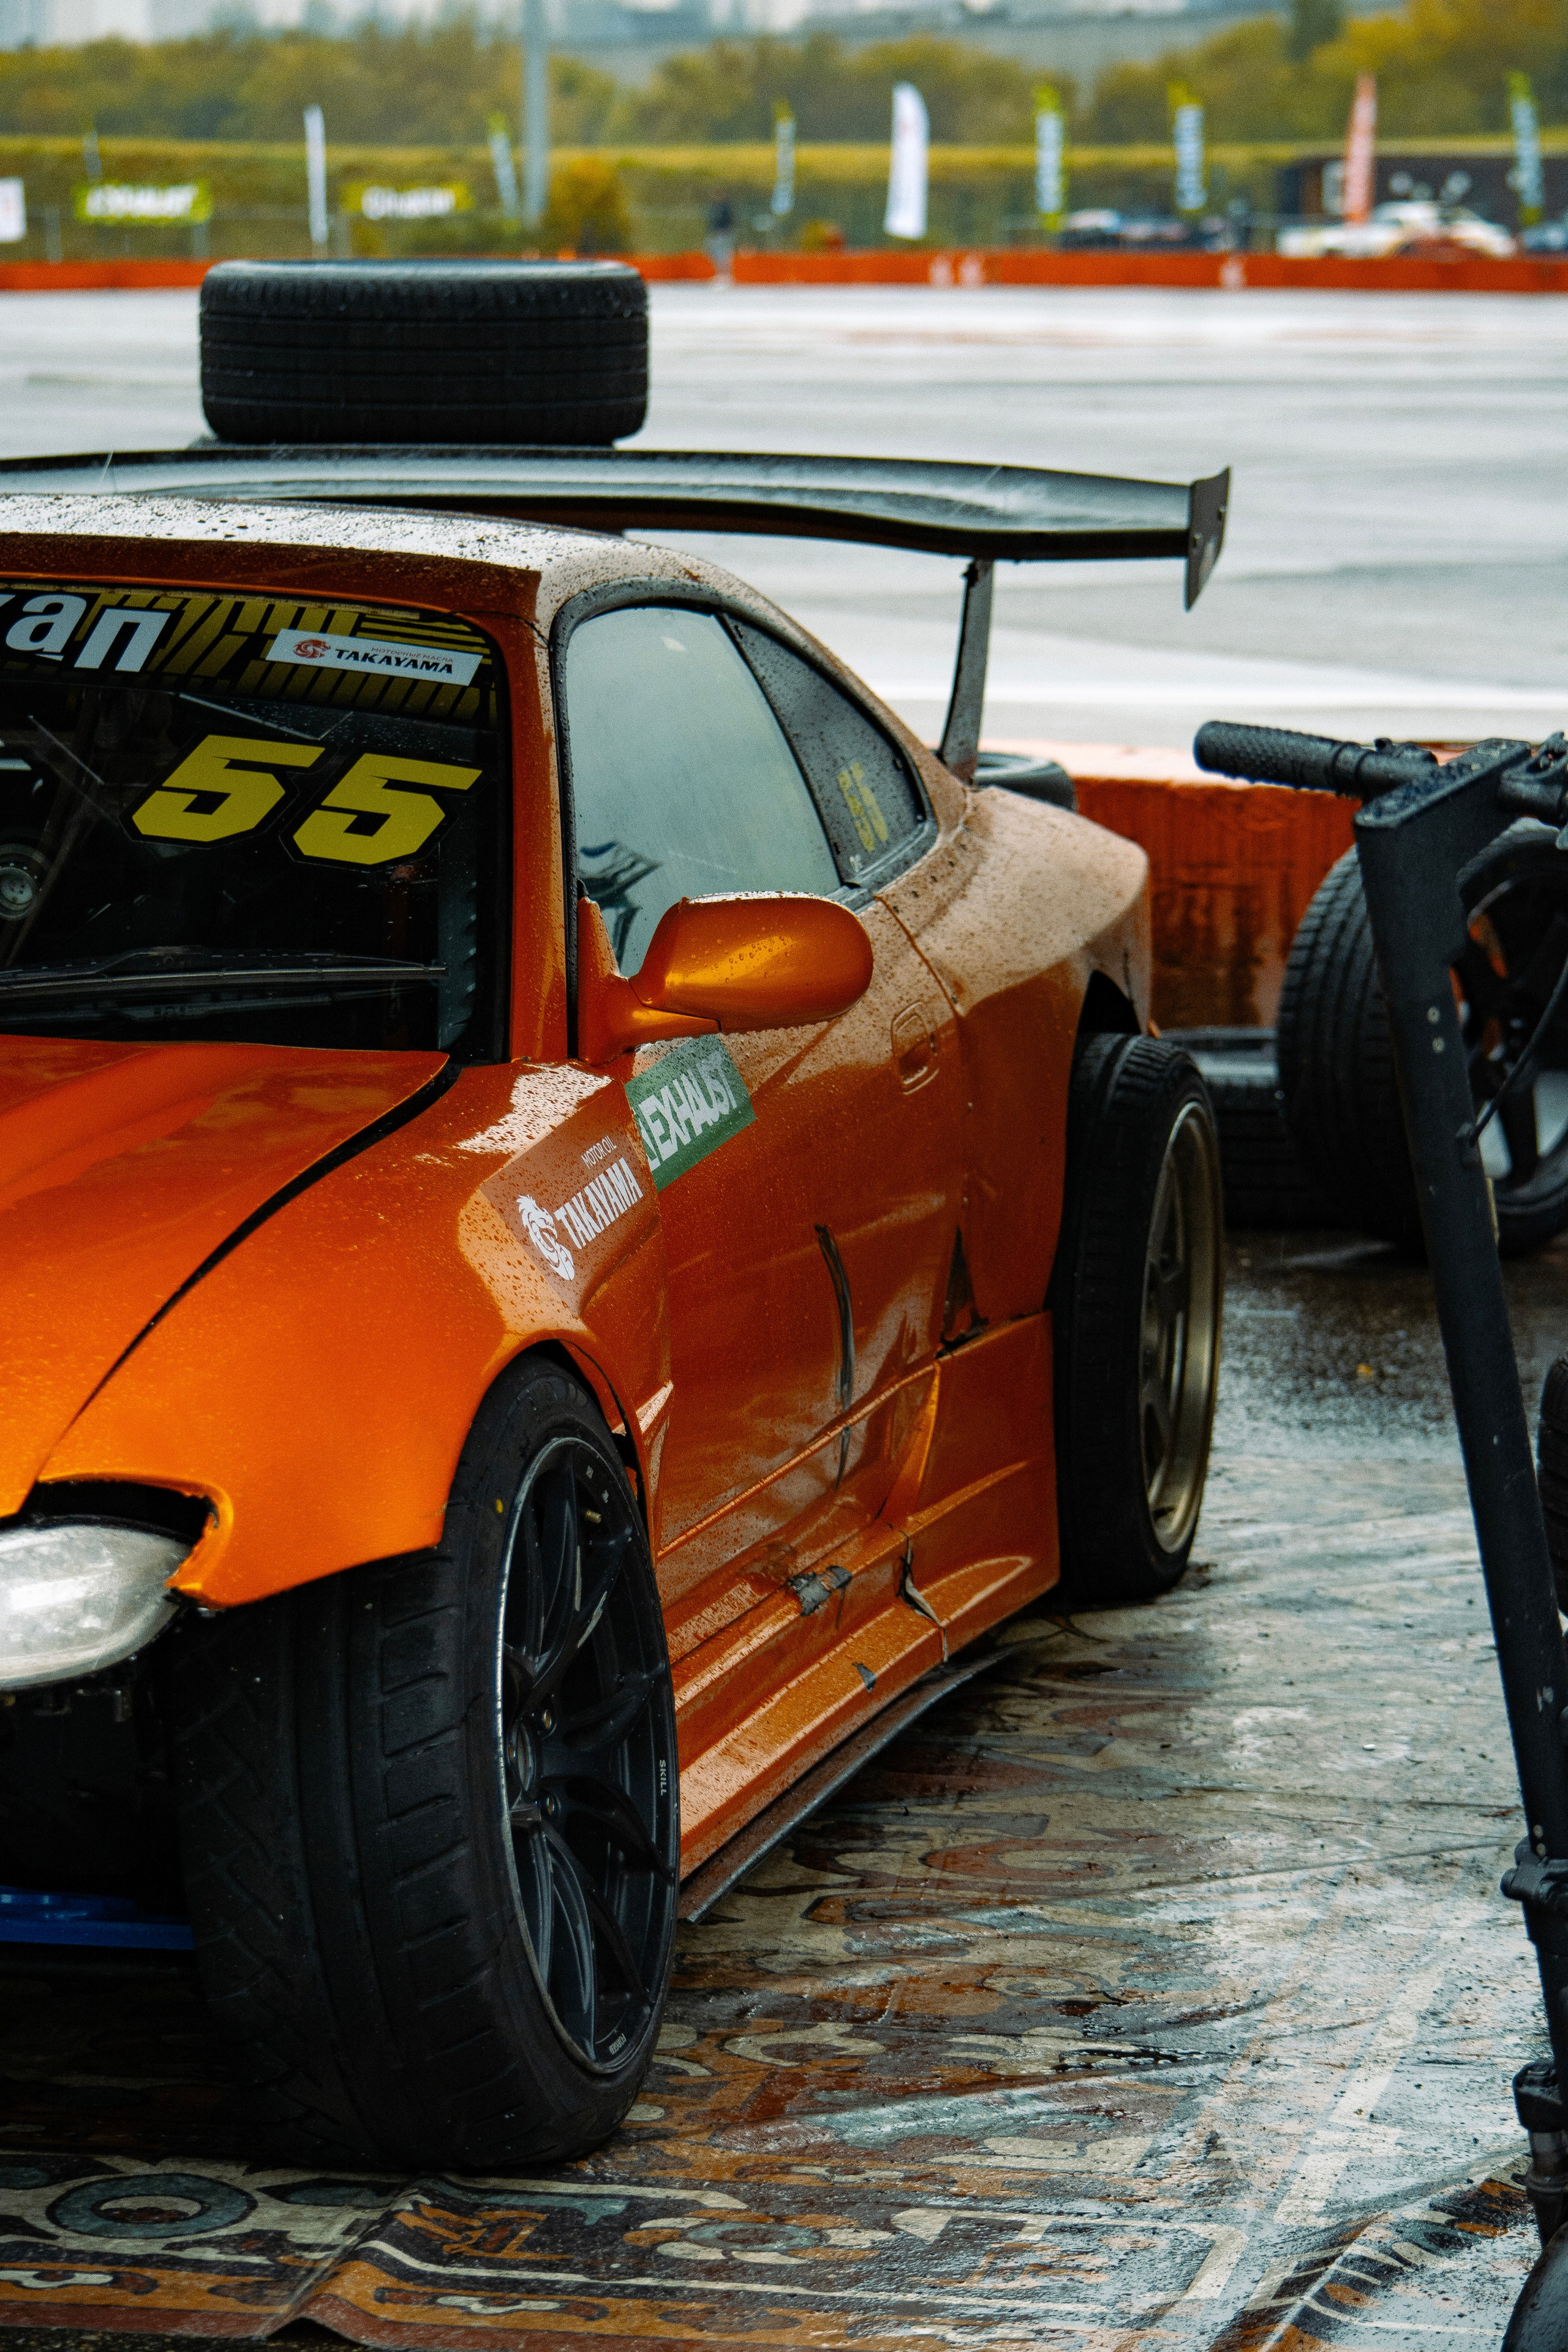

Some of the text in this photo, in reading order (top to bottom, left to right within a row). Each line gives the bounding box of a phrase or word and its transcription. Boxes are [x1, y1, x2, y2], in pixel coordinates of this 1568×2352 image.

[335, 648, 453, 674] TAKAYAMA
[131, 734, 483, 865] 55
[581, 1135, 617, 1169] MOTOR OIL
[554, 1157, 644, 1250] TAKAYAMA
